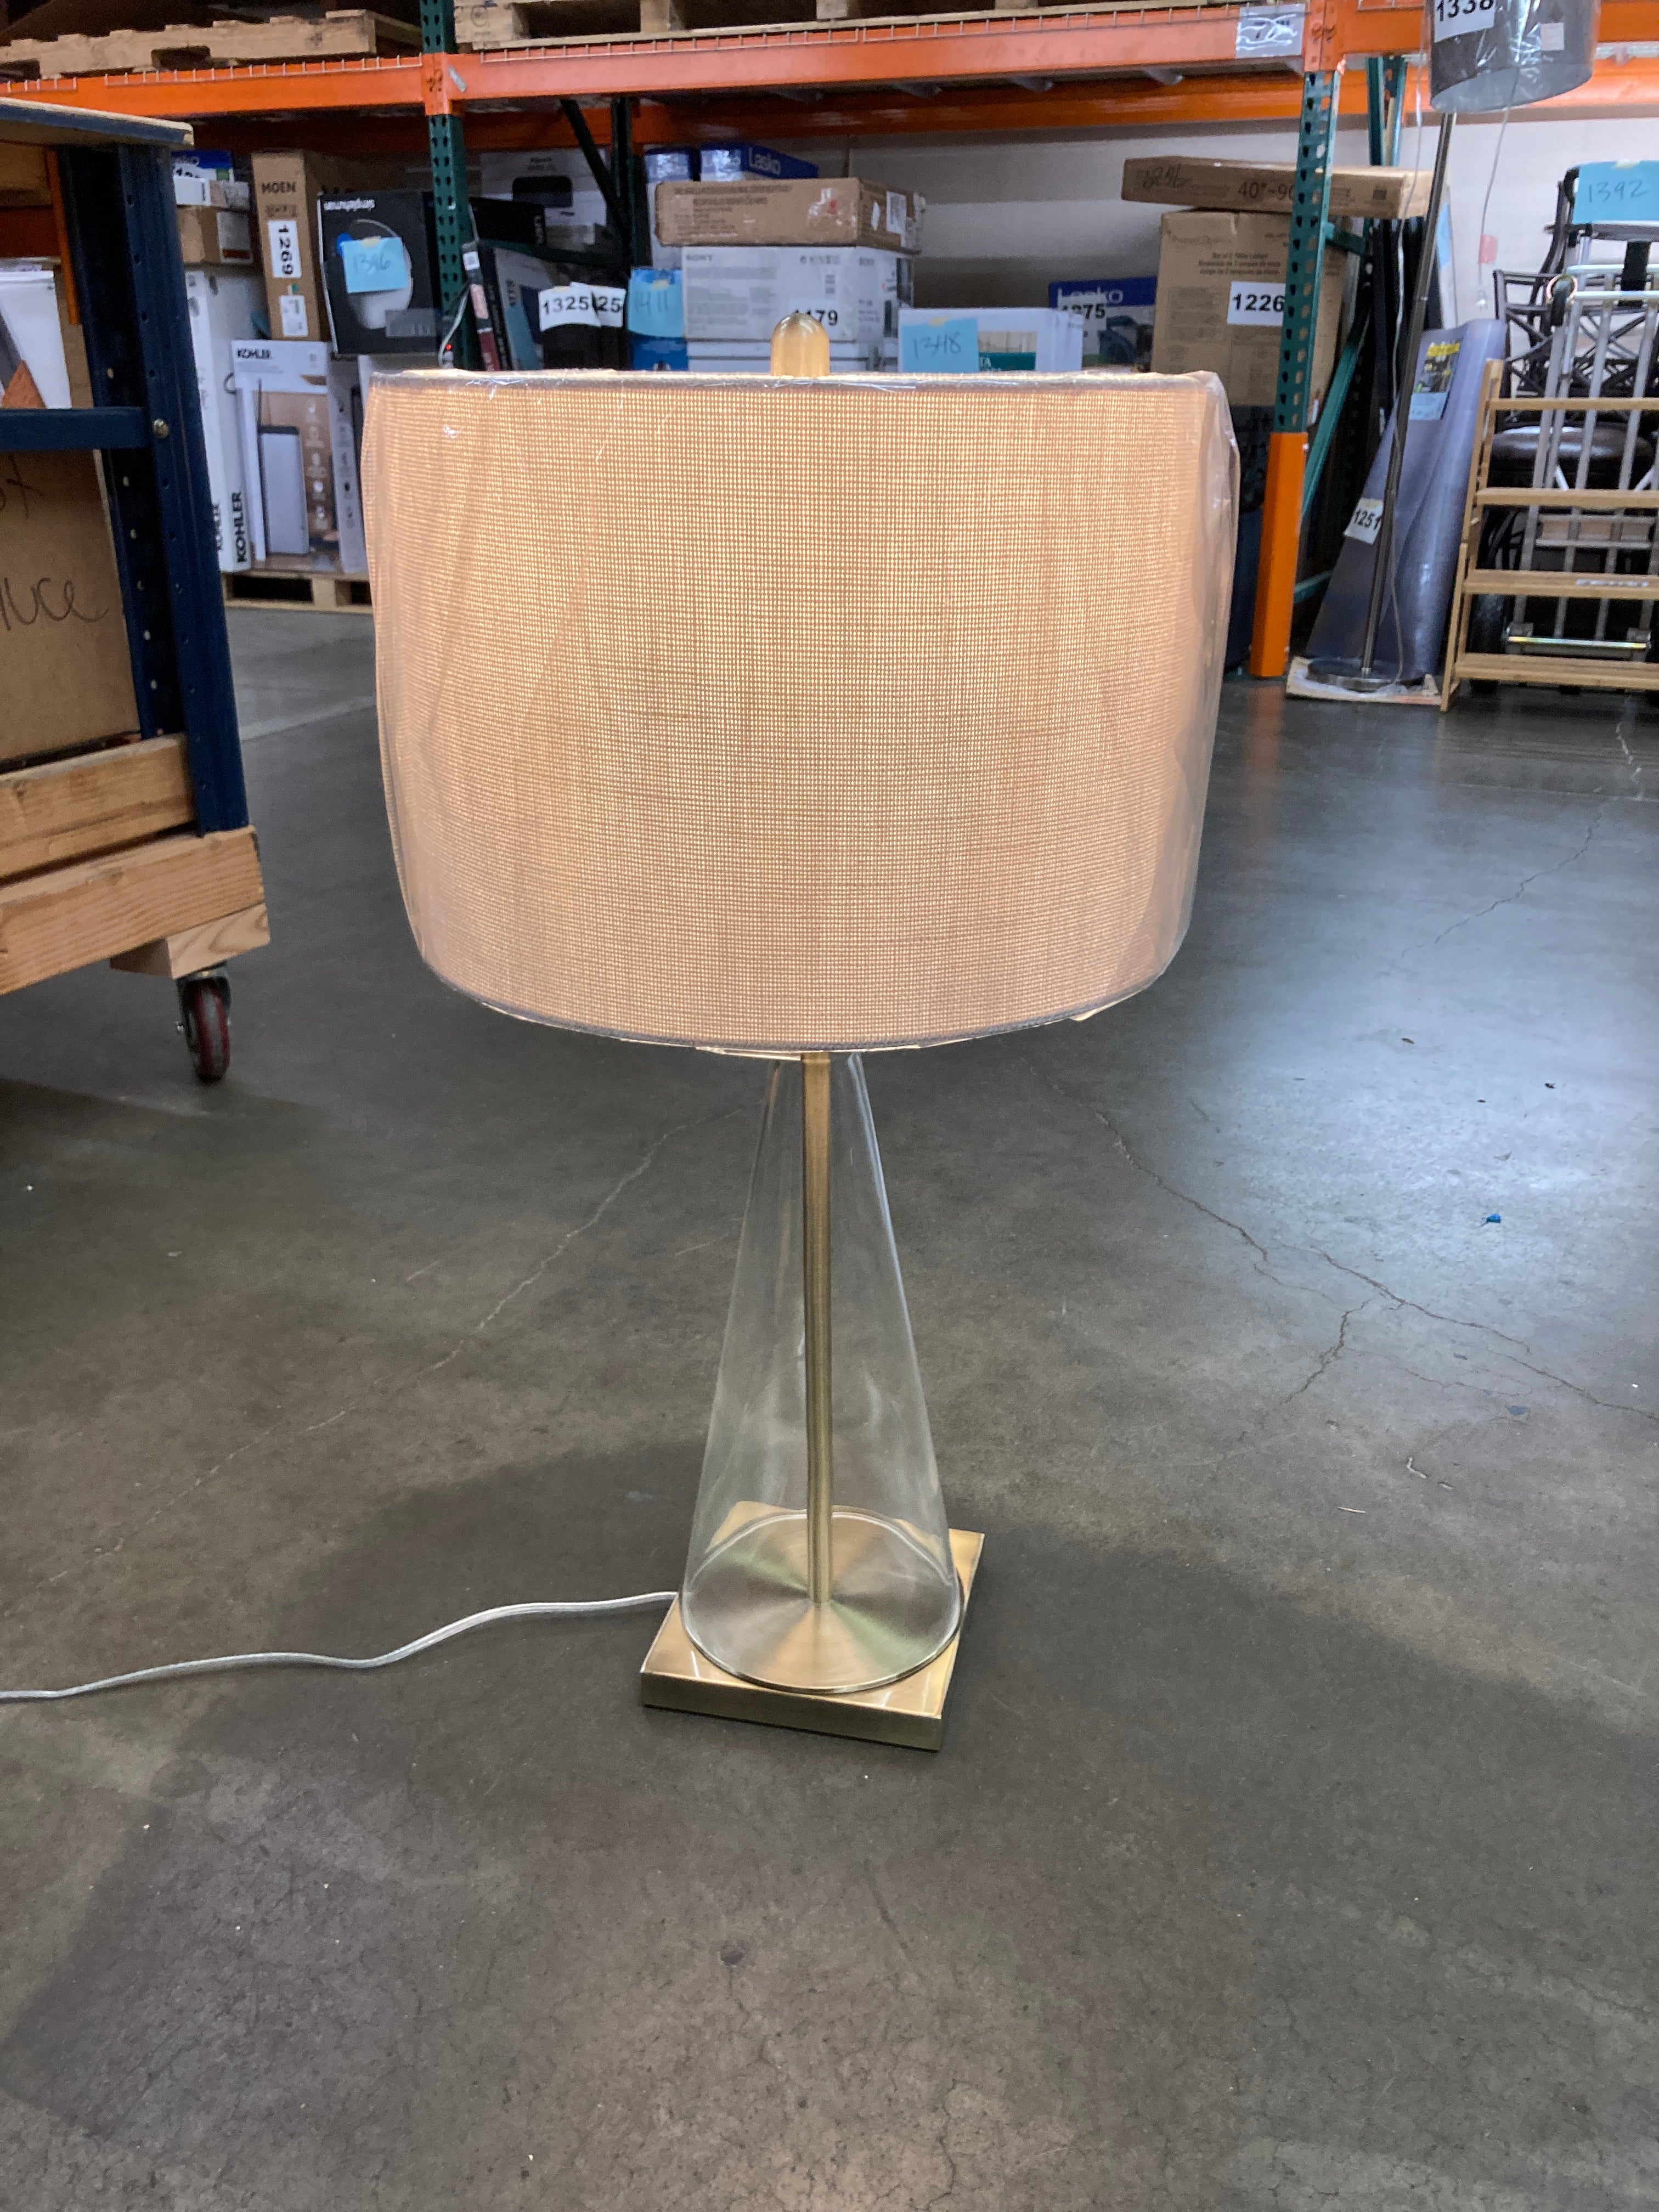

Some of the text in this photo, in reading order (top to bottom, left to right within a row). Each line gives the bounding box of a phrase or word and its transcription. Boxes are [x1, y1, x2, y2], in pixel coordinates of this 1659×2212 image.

[748, 146, 782, 177] Lasko
[261, 180, 297, 193] MOEN
[1588, 179, 1649, 203] 1392
[278, 223, 294, 275] 1269
[543, 295, 589, 314] 1325
[1233, 294, 1286, 312] 1226
[795, 309, 838, 326] 79
[913, 331, 961, 358] 1348
[232, 491, 247, 563] KOHLER
[1354, 509, 1381, 531] 1251
